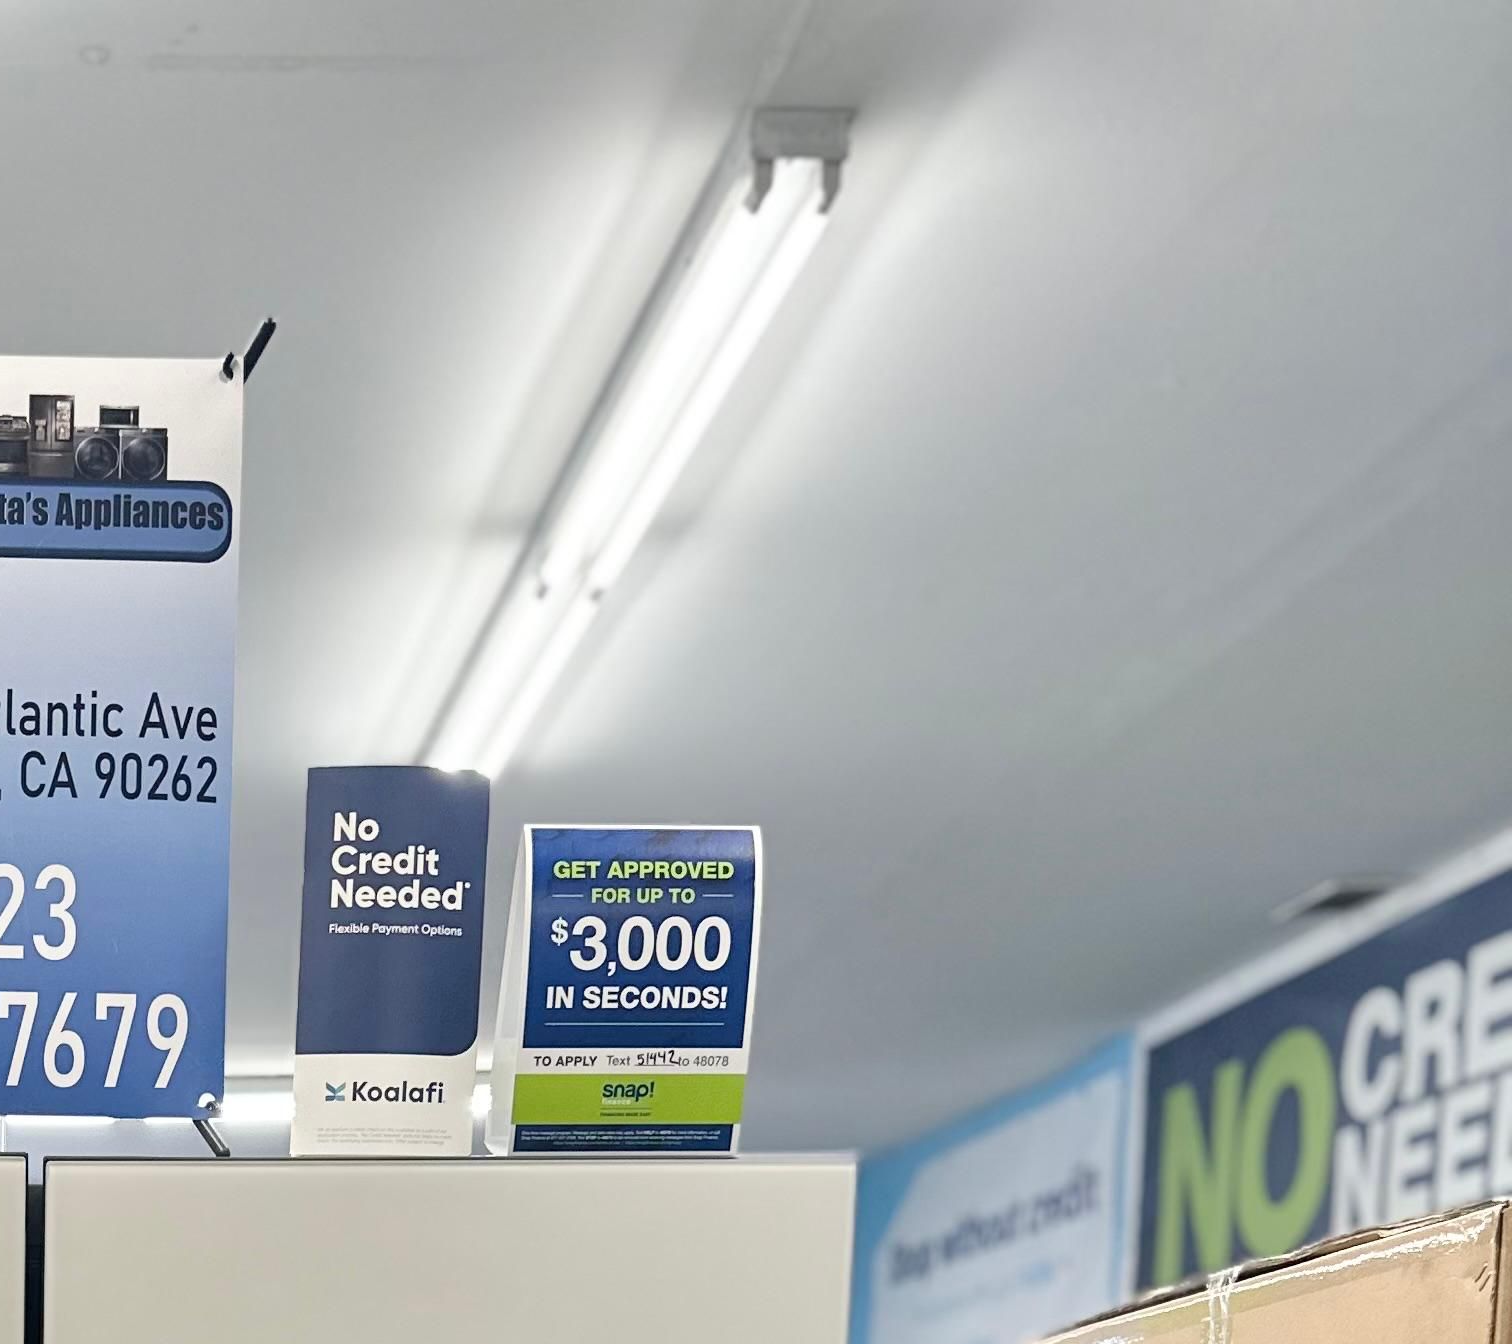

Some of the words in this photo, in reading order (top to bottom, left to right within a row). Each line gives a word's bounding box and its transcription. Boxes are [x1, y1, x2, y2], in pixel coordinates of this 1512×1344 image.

[56, 493, 225, 531] Appliances
[138, 692, 218, 742] Ave
[20, 751, 78, 800] CA
[94, 752, 218, 804] 90262
[333, 811, 380, 842] No
[331, 845, 440, 876] Credit
[553, 860, 601, 880] GET
[607, 861, 735, 880] APPROVED
[591, 888, 631, 904] FOR
[637, 888, 663, 904] UP
[669, 888, 696, 904] TO
[328, 923, 370, 934] Flexible
[371, 923, 419, 936] Payment
[421, 924, 463, 937] Options
[550, 915, 732, 977] $3,000
[546, 986, 575, 1009] IN
[582, 986, 728, 1009] SECONDS!
[533, 1056, 552, 1067] TO
[555, 1055, 598, 1067] APPLY
[606, 1055, 631, 1067] Text
[678, 1056, 690, 1067] to
[692, 1055, 729, 1067] 48078
[352, 1080, 444, 1104] Koalafi
[602, 1081, 655, 1102] snap!
[1157, 1026, 1335, 1289] NO
